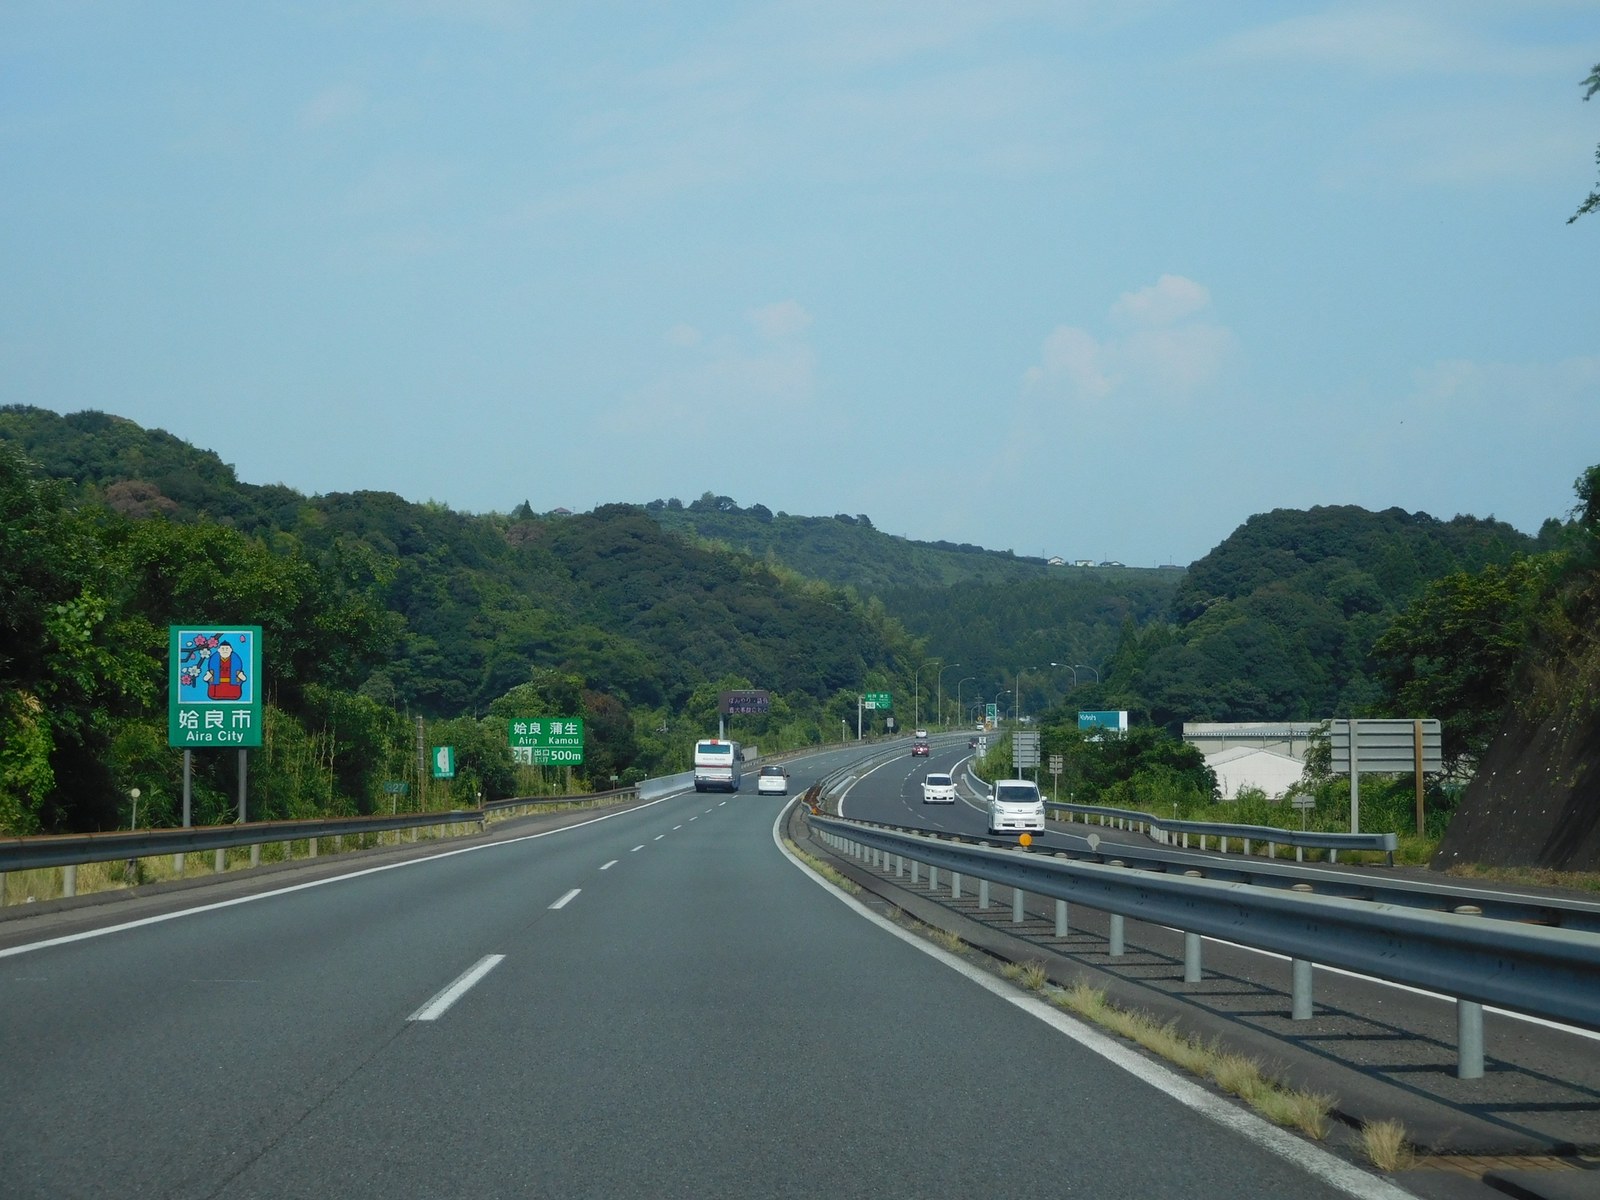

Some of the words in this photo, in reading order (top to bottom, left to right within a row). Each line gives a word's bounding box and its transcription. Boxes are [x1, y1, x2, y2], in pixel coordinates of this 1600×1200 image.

[179, 709, 252, 729] 姶良市
[513, 721, 542, 735] 姶良
[549, 721, 578, 735] 蒲生
[186, 731, 213, 741] Aira
[217, 730, 244, 743] City
[518, 736, 538, 745] Aira
[548, 736, 579, 745] Kamou
[534, 748, 550, 757] 出口
[551, 750, 581, 760] 500m
